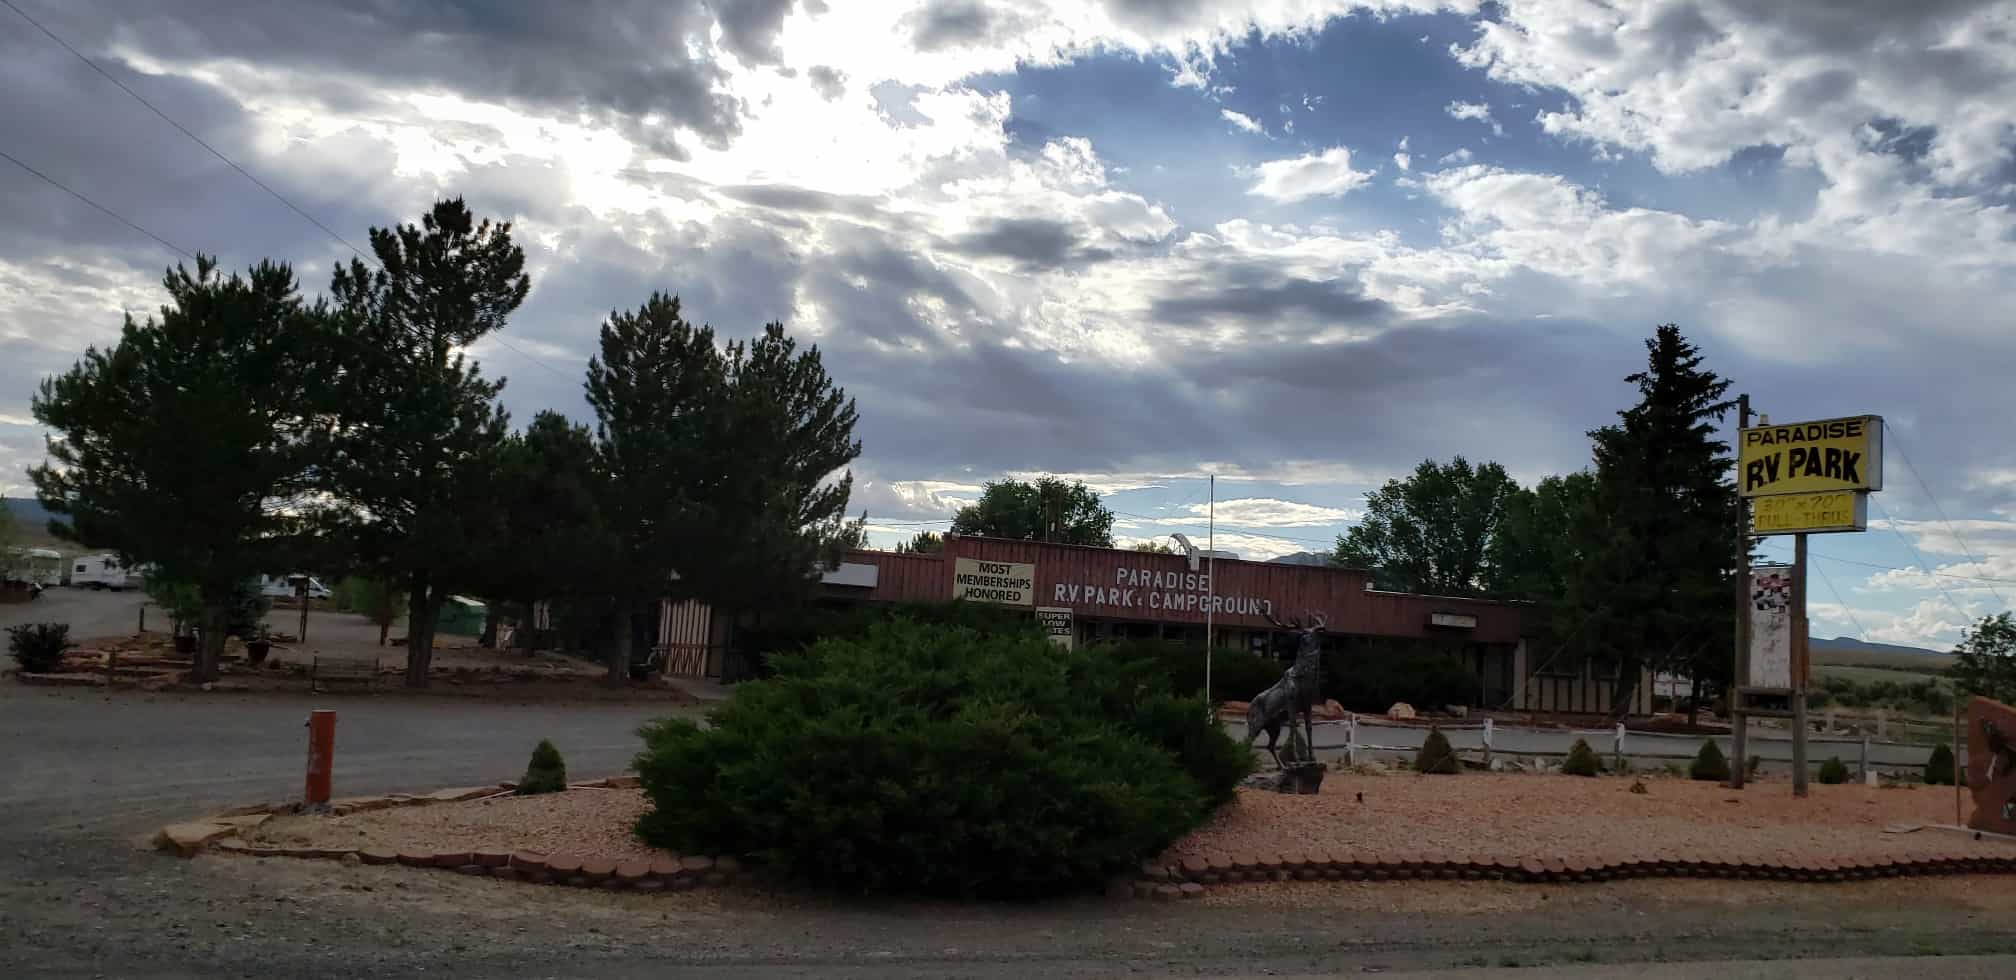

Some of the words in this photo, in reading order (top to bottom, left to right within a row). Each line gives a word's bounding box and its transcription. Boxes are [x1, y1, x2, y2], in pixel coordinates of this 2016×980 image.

[1747, 421, 1863, 447] PARADISE
[1788, 447, 1862, 485] PARK
[979, 563, 1012, 575] MOST
[957, 574, 1031, 590] MEMBERSHIPS
[1116, 567, 1209, 592] PARADISE
[965, 587, 1022, 602] HONORED
[1084, 585, 1133, 607] PARK
[1149, 591, 1273, 616] CAMPGROUND
[1038, 611, 1071, 620] SUPER
[1040, 619, 1066, 627] LOW
